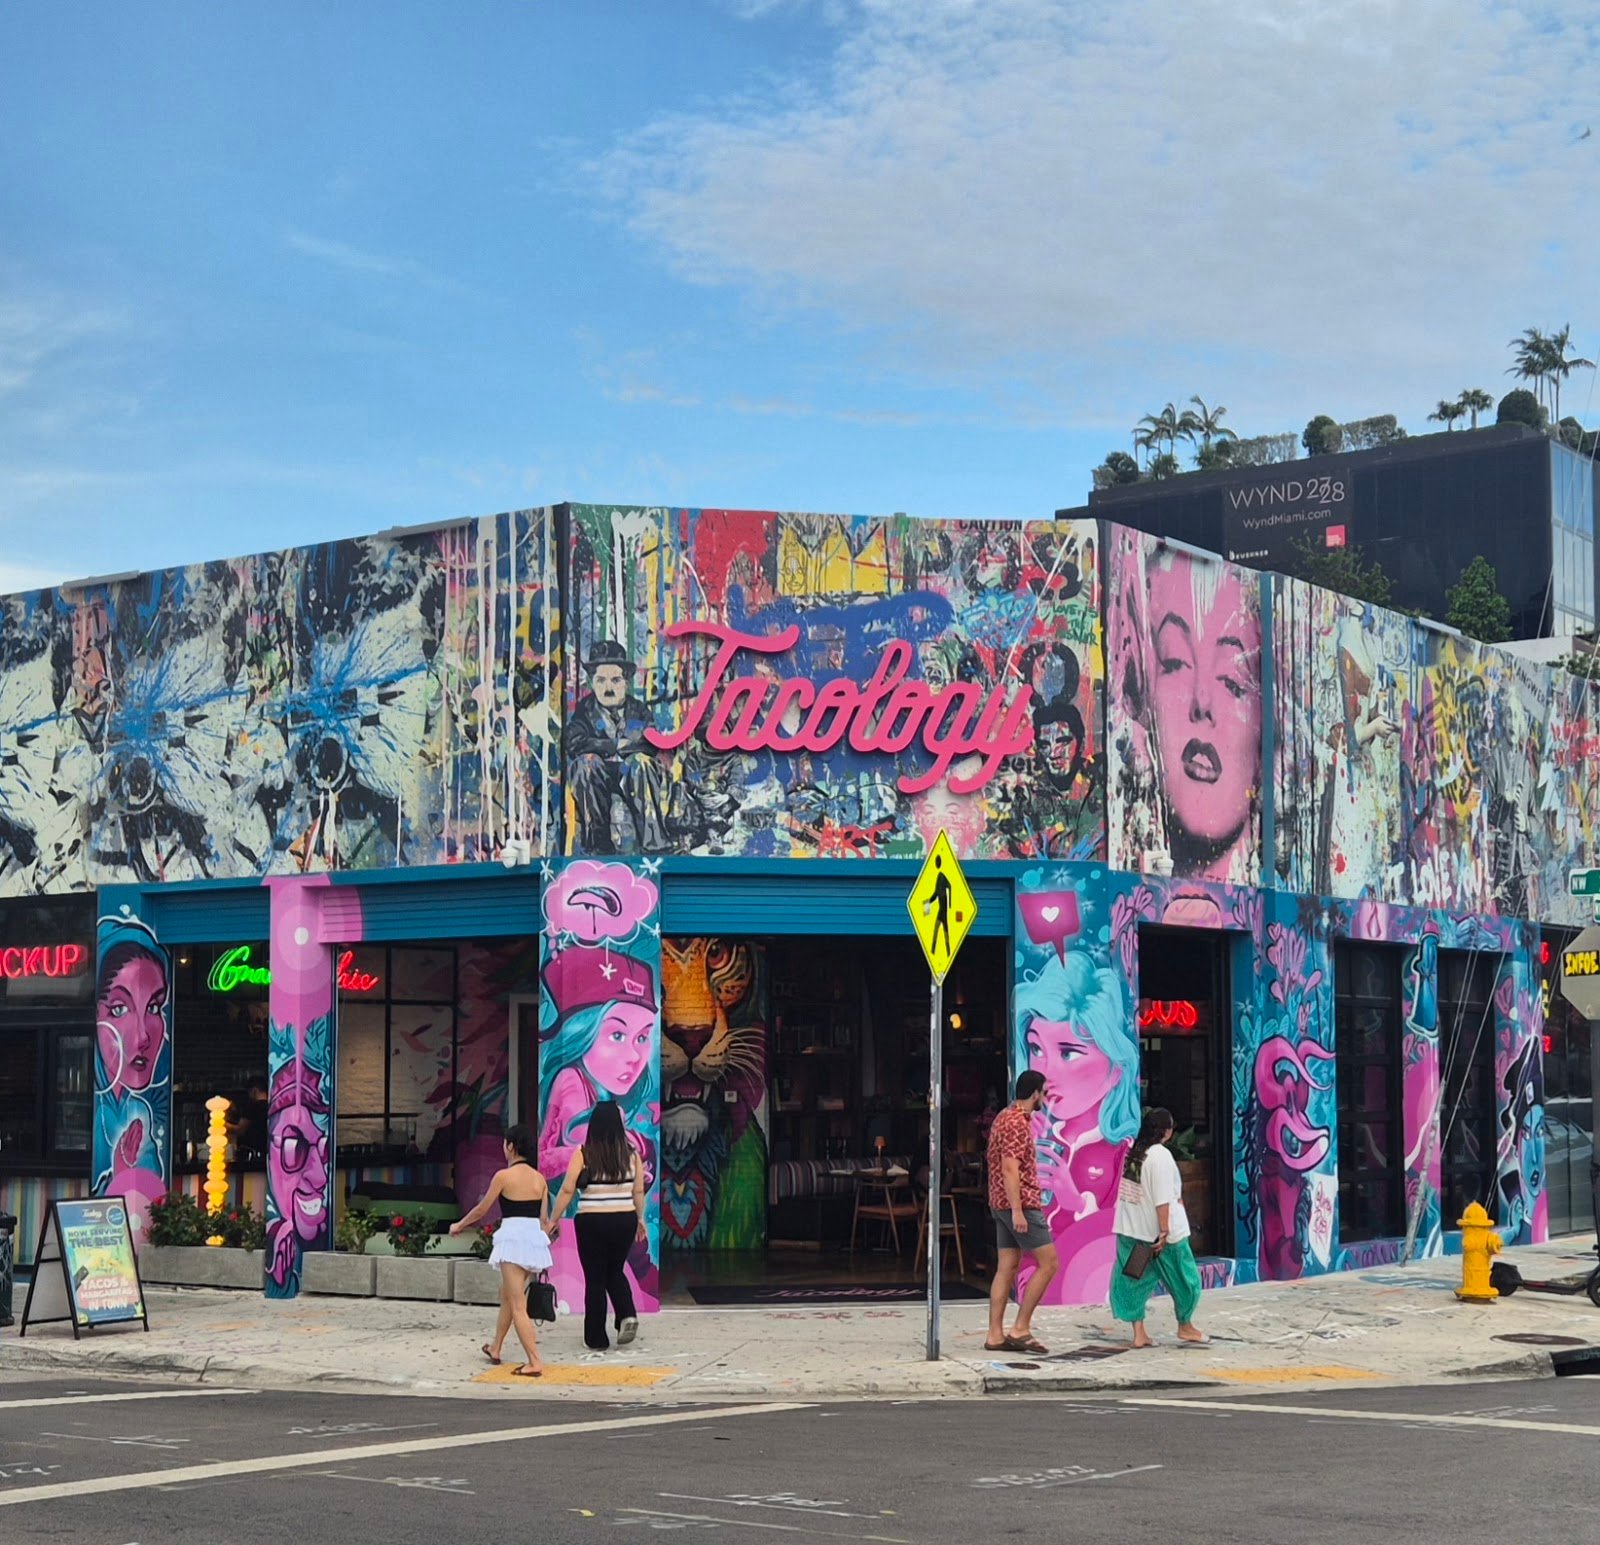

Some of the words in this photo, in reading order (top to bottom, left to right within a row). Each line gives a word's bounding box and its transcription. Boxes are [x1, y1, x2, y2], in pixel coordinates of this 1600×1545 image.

[1229, 482, 1303, 509] WYND
[1243, 509, 1331, 530] WyndMiami.com
[643, 621, 1034, 794] Tacology
[1572, 876, 1587, 891] NW
[69, 1238, 93, 1248] THE
[95, 1236, 124, 1246] BEST
[82, 1278, 119, 1290] TACOS
